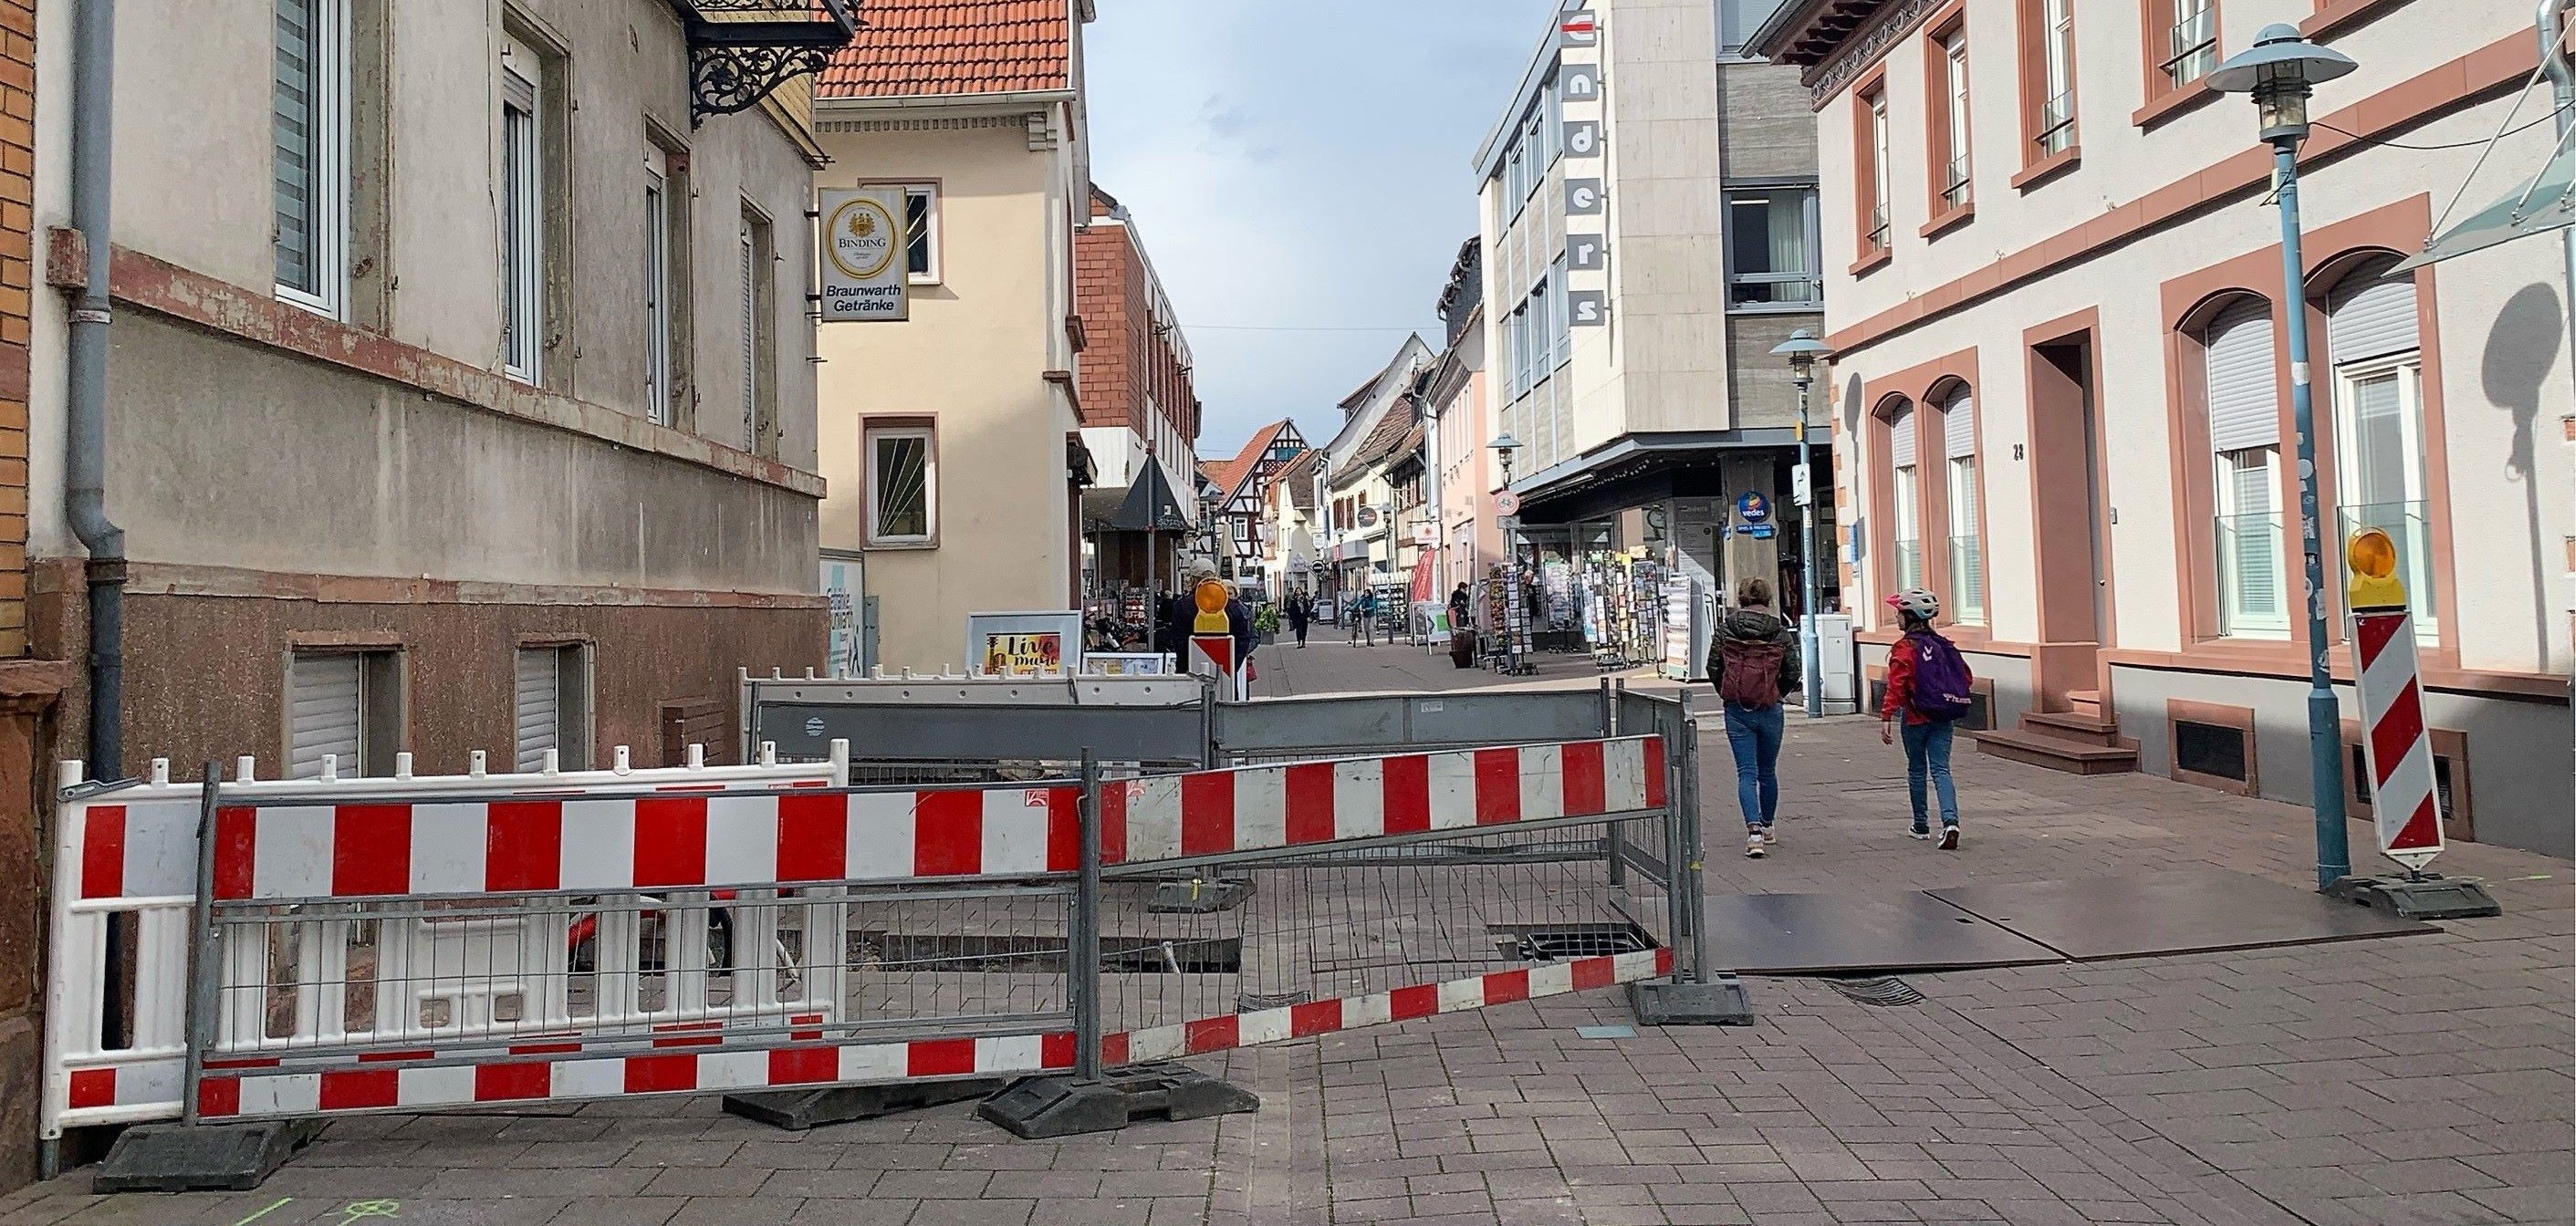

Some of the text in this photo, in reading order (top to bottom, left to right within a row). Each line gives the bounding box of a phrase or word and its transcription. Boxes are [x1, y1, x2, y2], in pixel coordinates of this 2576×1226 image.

[826, 284, 902, 297] Braunwarth
[833, 299, 894, 312] Getränke
[2013, 443, 2024, 461] 28
[1742, 509, 1765, 517] vedes
[1007, 636, 1054, 656] Live
[1014, 655, 1058, 667] music
